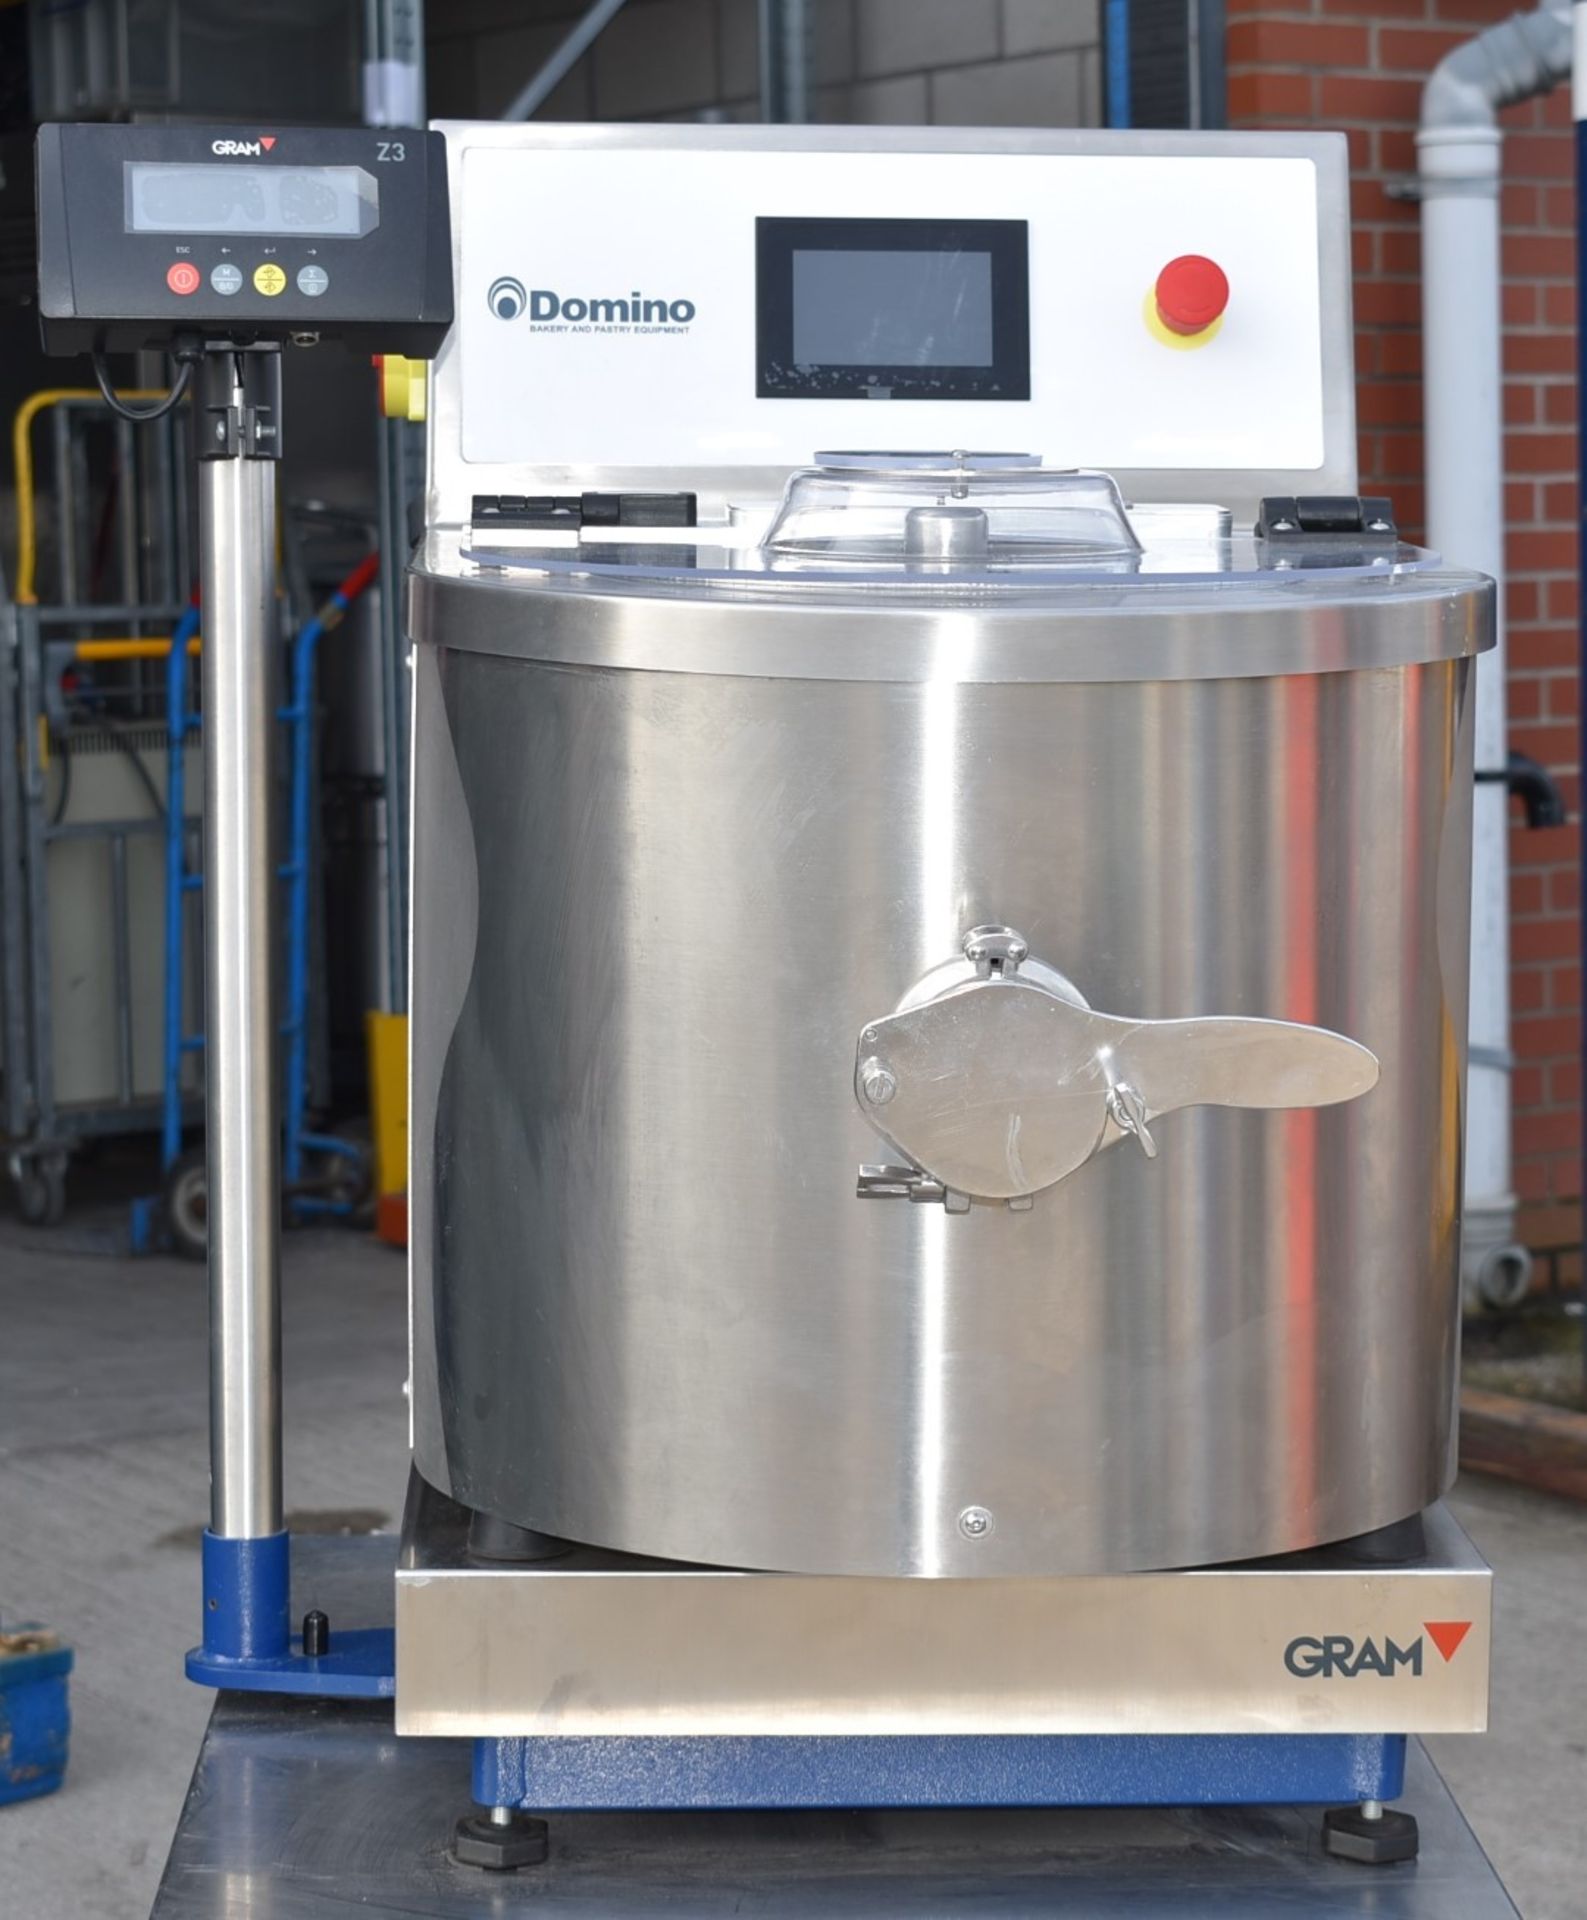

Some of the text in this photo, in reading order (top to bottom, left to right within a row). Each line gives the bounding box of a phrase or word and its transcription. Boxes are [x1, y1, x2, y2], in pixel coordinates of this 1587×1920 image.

[212, 140, 261, 156] GRAM
[377, 142, 406, 162] Z3
[175, 246, 190, 254] ESC
[530, 290, 696, 323] Domino
[530, 325, 690, 334] BAKERY AND PASTRY EQUIPMENT
[1284, 1635, 1423, 1678] GRAM
